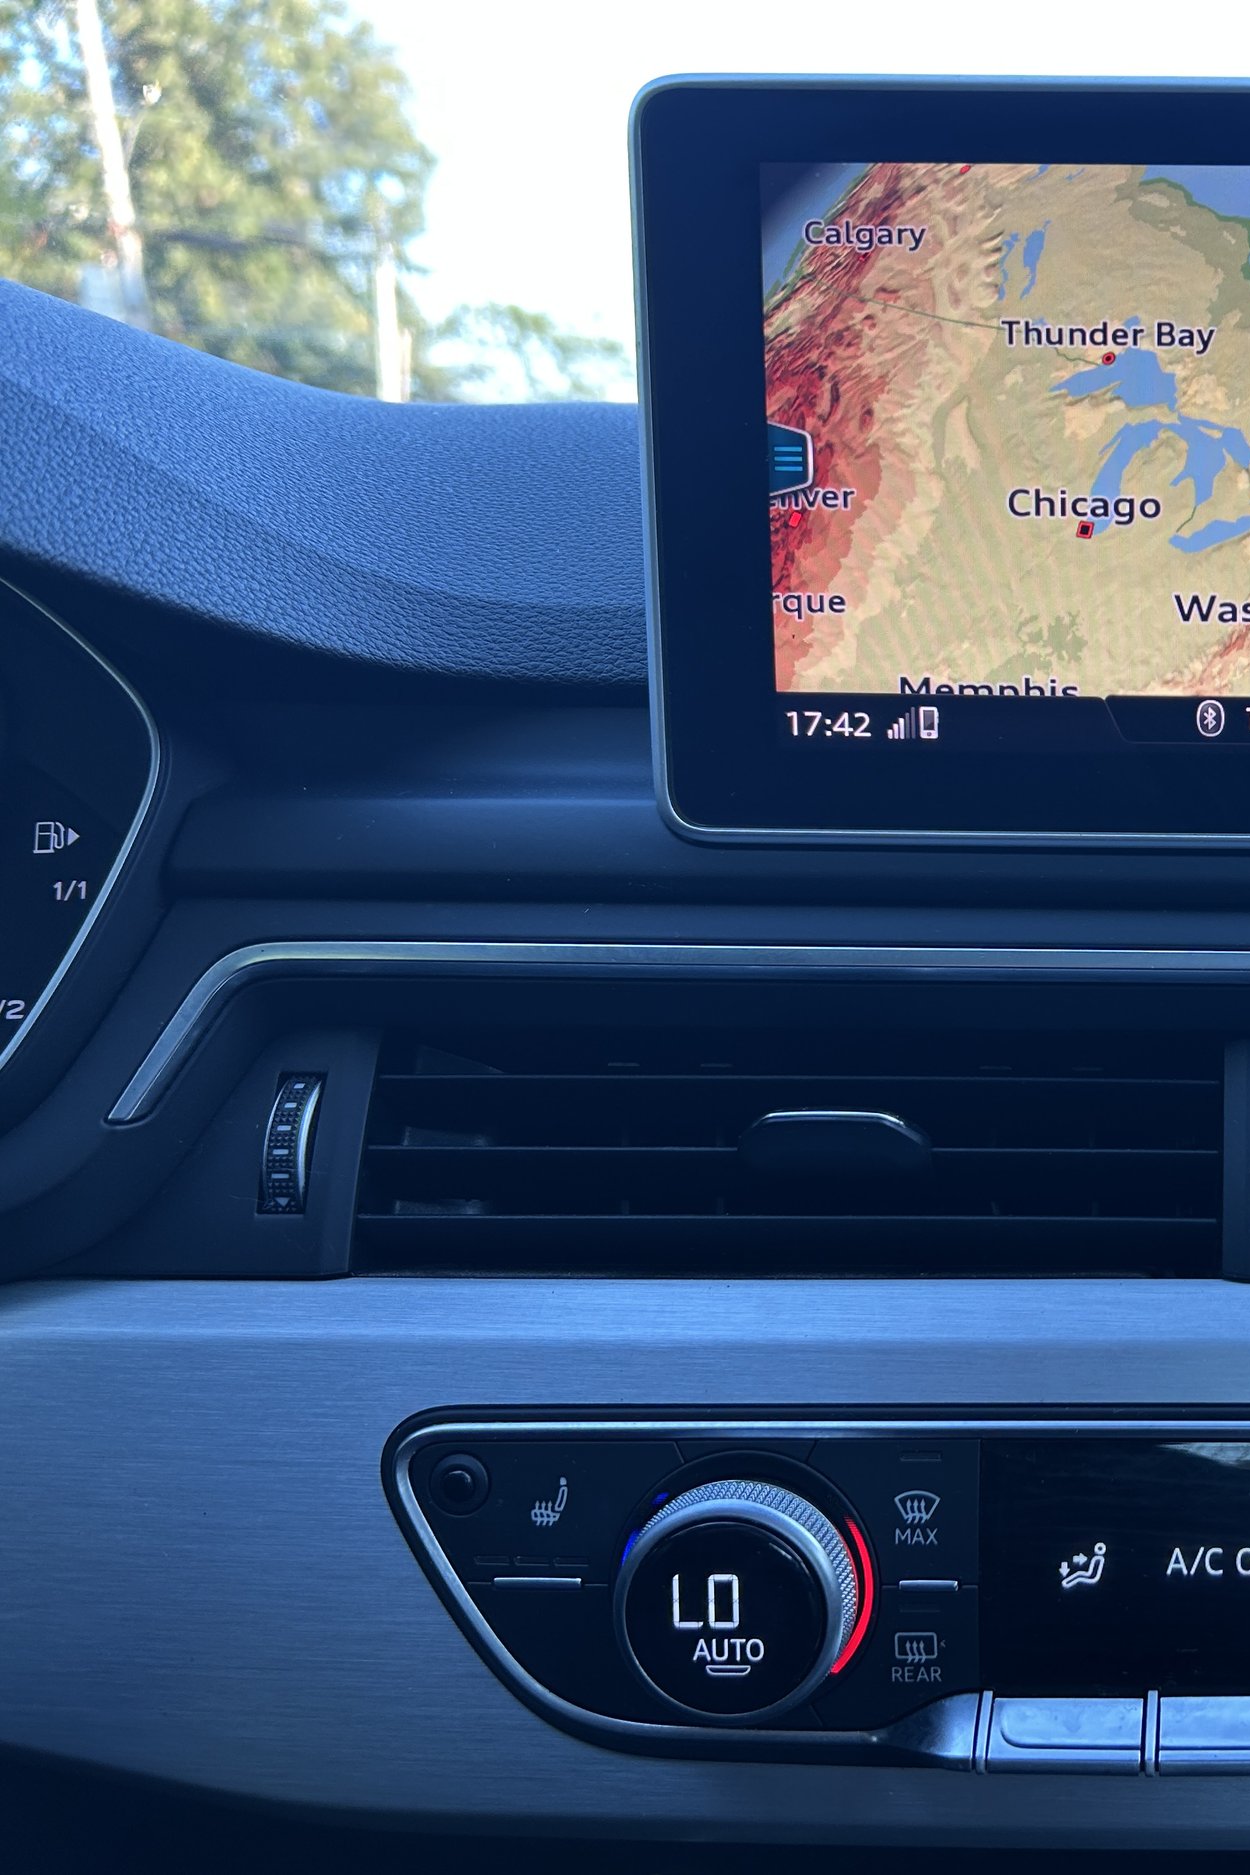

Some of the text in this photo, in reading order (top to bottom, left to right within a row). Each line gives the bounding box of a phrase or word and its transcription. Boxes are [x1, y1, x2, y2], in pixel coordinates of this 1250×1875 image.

[804, 220, 926, 251] Calgary
[1001, 320, 1216, 355] Thunder Bay
[770, 488, 854, 509] nver
[1008, 488, 1161, 524] Chicago
[785, 711, 872, 738] 17:42
[53, 880, 87, 901] 1/1
[894, 1527, 939, 1545] MAX
[1166, 1546, 1224, 1578] A/C
[672, 1573, 741, 1630] LO
[692, 1638, 765, 1662] AUTO
[890, 1666, 943, 1683] REAR
